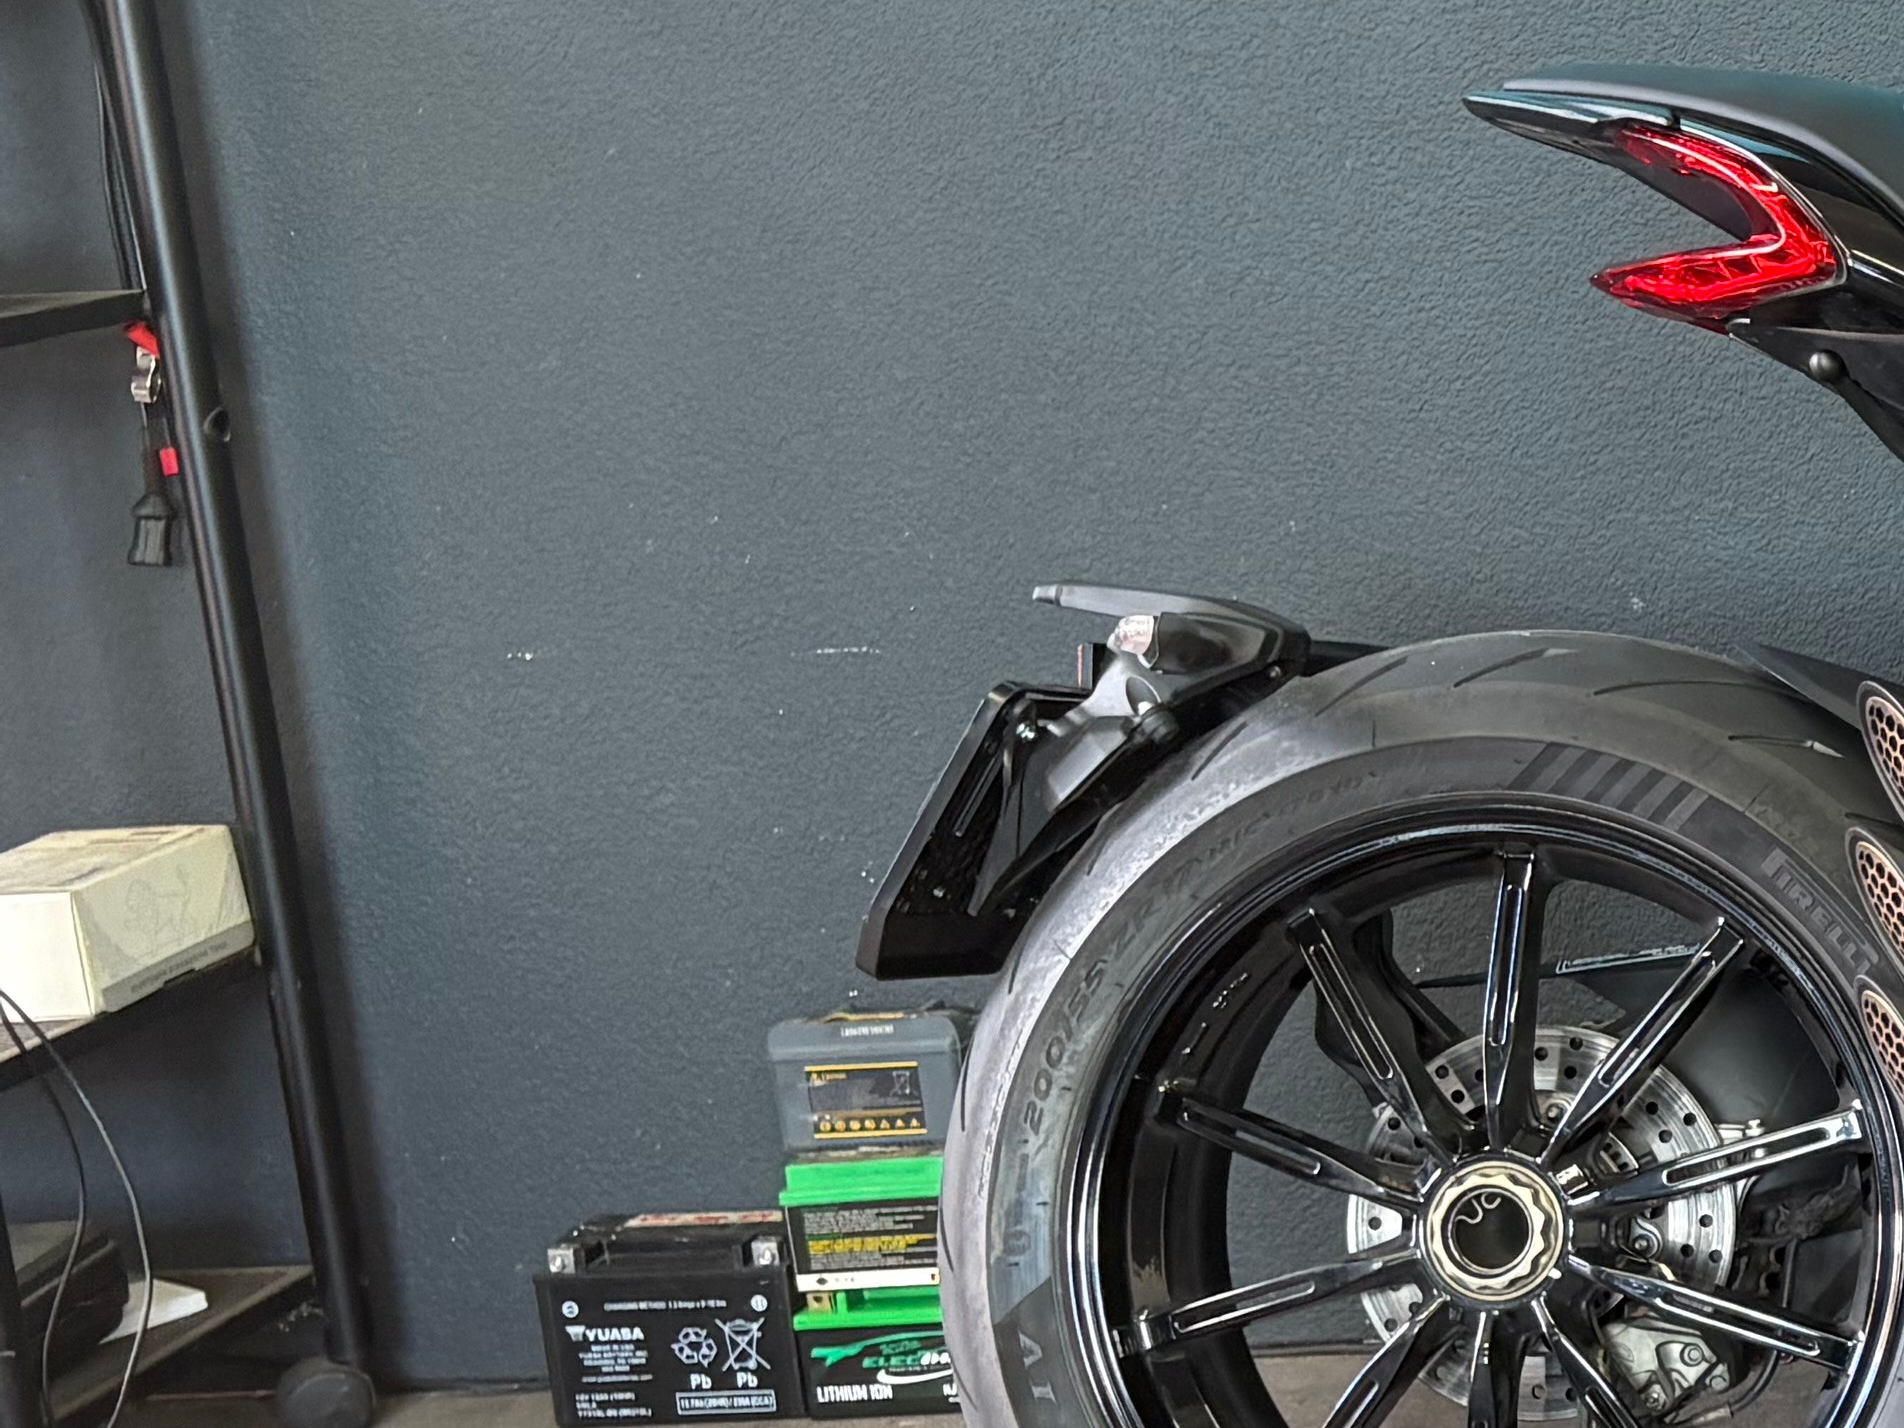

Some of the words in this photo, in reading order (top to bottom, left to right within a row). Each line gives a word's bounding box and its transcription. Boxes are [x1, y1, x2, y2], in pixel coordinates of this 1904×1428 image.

[1760, 847, 1879, 974] PIRELLI
[585, 1327, 645, 1342] YUASA
[1018, 1331, 1057, 1405] IV
[690, 1373, 712, 1390] Pb
[736, 1371, 758, 1388] Pb
[816, 1384, 868, 1403] LITHIUM
